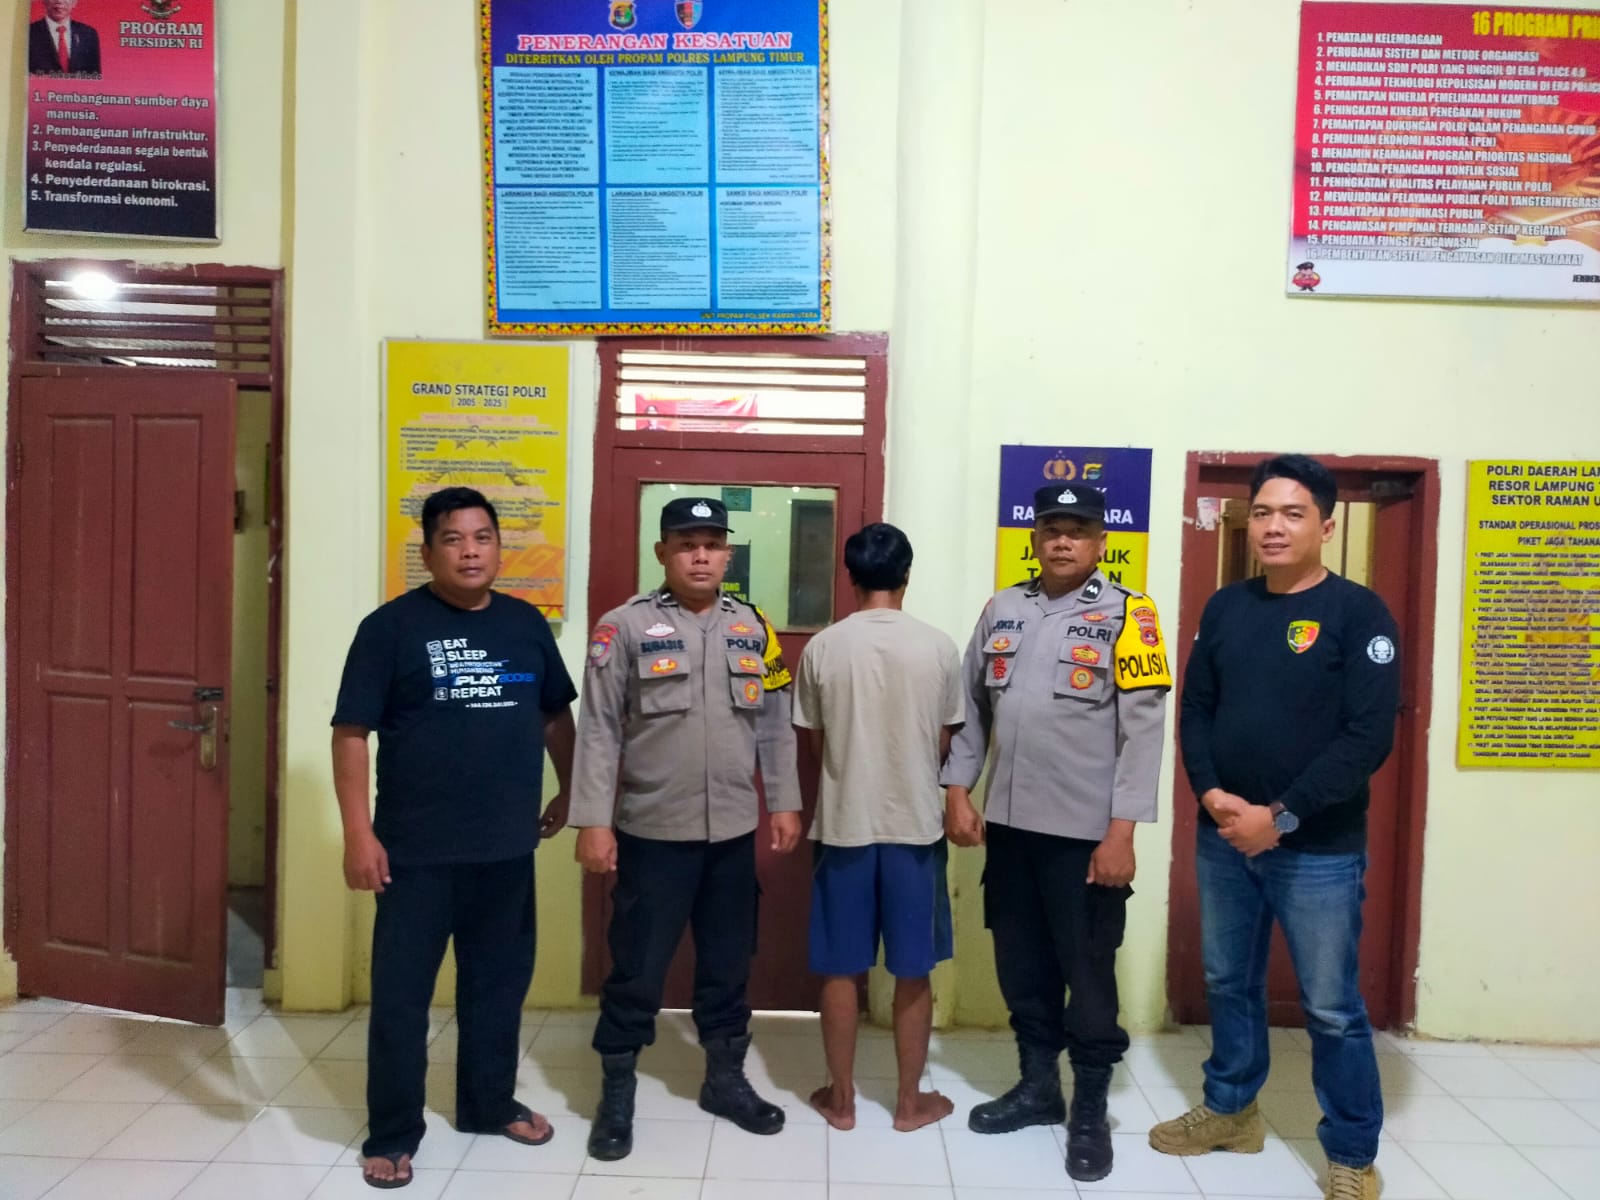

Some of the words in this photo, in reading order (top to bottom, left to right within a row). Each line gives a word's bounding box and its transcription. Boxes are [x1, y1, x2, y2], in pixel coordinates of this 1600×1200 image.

[119, 22, 204, 36] PROGRAM
[1472, 12, 1490, 36] 16
[1494, 12, 1570, 38] PROGRAM
[120, 37, 186, 48] PRESIDEN
[189, 38, 204, 48] RI
[517, 33, 668, 51] PENERANGAN
[672, 32, 792, 50] KESATUAN
[1317, 32, 1325, 43] 1.
[1326, 32, 1374, 43] PENATAAN
[1375, 33, 1442, 45] KELEMBAGAAN
[505, 53, 582, 65] DITERBITKAN
[584, 53, 614, 65] OLEH
[618, 53, 664, 65] PROPAM
[667, 52, 710, 64] POLRES
[713, 52, 766, 63] LAMPUNG
[769, 51, 804, 62] TIMUR
[1316, 46, 1325, 58] 2.
[1327, 46, 1383, 58] PERUBAHAN
[1384, 48, 1420, 59] SISTEM
[1421, 48, 1441, 60] DAN
[1442, 49, 1480, 60] METODE
[1482, 50, 1539, 62] ORGANISASI
[1316, 61, 1324, 72] 3.
[1326, 61, 1386, 72] MENJADIKAN
[1387, 62, 1409, 73] SDM
[1410, 63, 1438, 74] POLRI
[1441, 64, 1464, 74] YANG
[1466, 64, 1504, 76] UNGGUL
[1506, 65, 1516, 76] DI
[1518, 66, 1536, 76] ERA
[1538, 66, 1570, 78] POLICE
[1314, 76, 1324, 87] 4.
[1325, 76, 1382, 88] PERUBAHAN
[1384, 76, 1434, 88] TEKNOLOGI
[1498, 80, 1538, 90] MODERN
[1540, 80, 1550, 91] DI
[1552, 81, 1570, 92] ERA
[34, 92, 45, 102] 1.
[47, 92, 132, 106] Pembangunan
[134, 95, 178, 106] sumber
[181, 97, 209, 109] daya
[1314, 90, 1324, 101] 5.
[1325, 90, 1387, 102] PEMANTAPAN
[1388, 91, 1427, 102] KINERJA
[1428, 92, 1500, 104] PEMELIHARAAN
[1501, 94, 1558, 105] KAMTIBMAS
[46, 110, 99, 120] manusia.
[1314, 104, 1323, 115] 6.
[1324, 104, 1388, 116] PENINGKATAN
[1390, 106, 1428, 116] KINERJA
[1430, 106, 1485, 118] PENEGAKAN
[1486, 108, 1521, 119] HUKUM
[32, 125, 43, 135] 2.
[46, 125, 129, 140] Pembangunan
[132, 129, 208, 142] infrastruktur.
[1313, 118, 1320, 130] 7.
[1322, 119, 1384, 130] PEMANTAPAN
[1386, 120, 1438, 131] DUKUNGAN
[1440, 121, 1467, 132] POLRI
[1468, 122, 1501, 133] DALAM
[1503, 123, 1565, 134] PENANGANAN
[1312, 133, 1320, 144] 8.
[1322, 134, 1376, 145] PEMULIHAN
[1378, 134, 1421, 146] EKONOMI
[1423, 135, 1468, 147] NASIONAL
[32, 142, 42, 152] 3.
[135, 145, 170, 158] segala
[172, 146, 208, 158] bentuk
[1312, 148, 1320, 158] 9.
[1322, 148, 1371, 159] MENJAMIN
[1372, 148, 1424, 160] KEAMANAN
[1426, 150, 1474, 161] PROGRAM
[1475, 151, 1525, 162] PRIORITAS
[1526, 152, 1572, 164] NASIONAL
[44, 158, 92, 170] kendala
[95, 160, 146, 173] regulasi.
[1311, 162, 1324, 173] 10.
[1326, 162, 1380, 174] PENGUATAN
[1382, 164, 1444, 175] PENANGANAN
[1446, 165, 1484, 176] KONFLIK
[1486, 166, 1519, 177] SOSIAL
[30, 174, 42, 184] 4.
[152, 178, 210, 192] birokrasi.
[1310, 176, 1322, 188] 11.
[1323, 177, 1388, 188] PENINGKATAN
[1388, 178, 1434, 190] KUALITAS
[1436, 180, 1488, 190] PELAYANAN
[1489, 181, 1523, 192] PUBLIK
[1524, 182, 1552, 192] POLRI
[31, 192, 42, 202] 5.
[44, 192, 122, 206] Transformasi
[124, 194, 178, 208] ekonomi.
[1310, 190, 1322, 202] 12.
[1324, 191, 1390, 203] MEWUJUDKAN
[1392, 192, 1444, 204] PELAYANAN
[1446, 194, 1480, 205] PUBLIK
[1482, 195, 1508, 206] POLRI
[1308, 205, 1320, 216] 13.
[1324, 206, 1386, 217] PEMANTAPAN
[1387, 207, 1448, 218] KOMUNIKASI
[1449, 208, 1484, 220] PUBLIK
[1308, 220, 1320, 231] 14.
[1322, 220, 1386, 232] PENGAWASAN
[1388, 222, 1436, 232] PIMPINAN
[1438, 222, 1486, 234] TERHADAP
[1488, 224, 1520, 235] SETIAP
[1522, 225, 1568, 236] KEGIATAN
[1307, 234, 1319, 246] 15.
[1322, 235, 1376, 246] PENGUATAN
[1377, 236, 1412, 247] FUNGSI
[1414, 237, 1480, 248] PENGAWASAN
[412, 382, 452, 396] GRAND
[455, 384, 509, 397] STRATEGI
[512, 386, 546, 398] POLRI
[1487, 464, 1524, 476] POLRI
[1528, 466, 1577, 477] DAERAH
[1488, 480, 1530, 492] RESOR
[1534, 481, 1594, 492] LAMPUNG
[1492, 494, 1542, 506] SEKTOR
[1546, 496, 1590, 506] RAMAN
[1479, 520, 1517, 530] STANDAR
[1519, 520, 1576, 530] OPERASIONAL
[1518, 537, 1542, 546] PIKET
[1545, 537, 1564, 546] JAGA
[1016, 620, 1024, 630] K
[1067, 625, 1112, 642] POLRI
[443, 638, 468, 650] EAT
[726, 638, 762, 652] POLRI
[446, 650, 488, 661] SLEEP
[455, 674, 500, 686] PLAY
[450, 686, 503, 699] REPEAT
